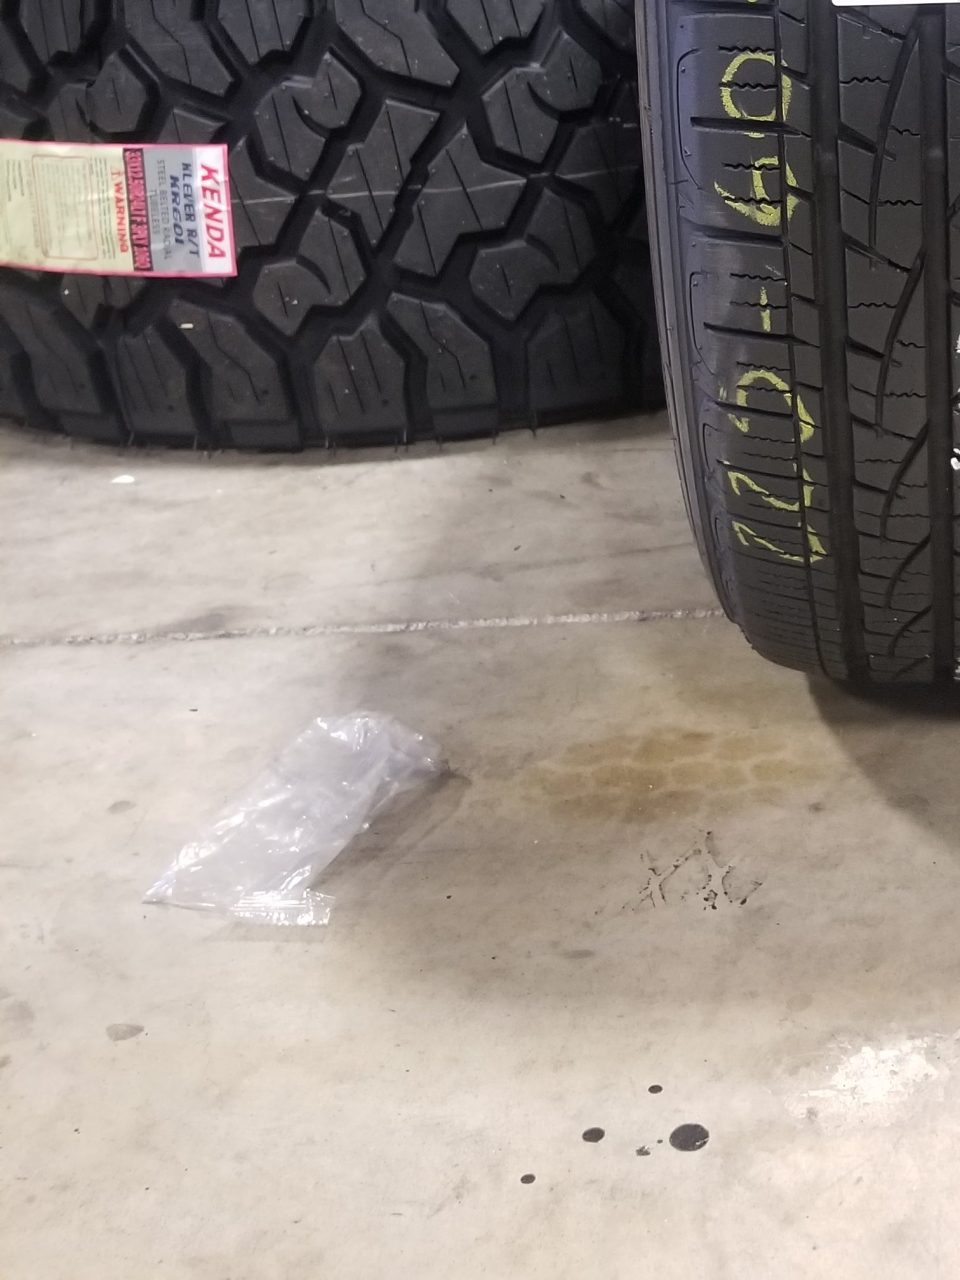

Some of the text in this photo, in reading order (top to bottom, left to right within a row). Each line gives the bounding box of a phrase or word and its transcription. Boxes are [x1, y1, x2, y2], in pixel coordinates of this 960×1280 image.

[157, 159, 166, 187] STEEL
[160, 189, 170, 226] BELTED
[114, 181, 129, 253] WARNING
[182, 162, 200, 258] KLEVER R/T
[200, 163, 226, 259] KENDA
